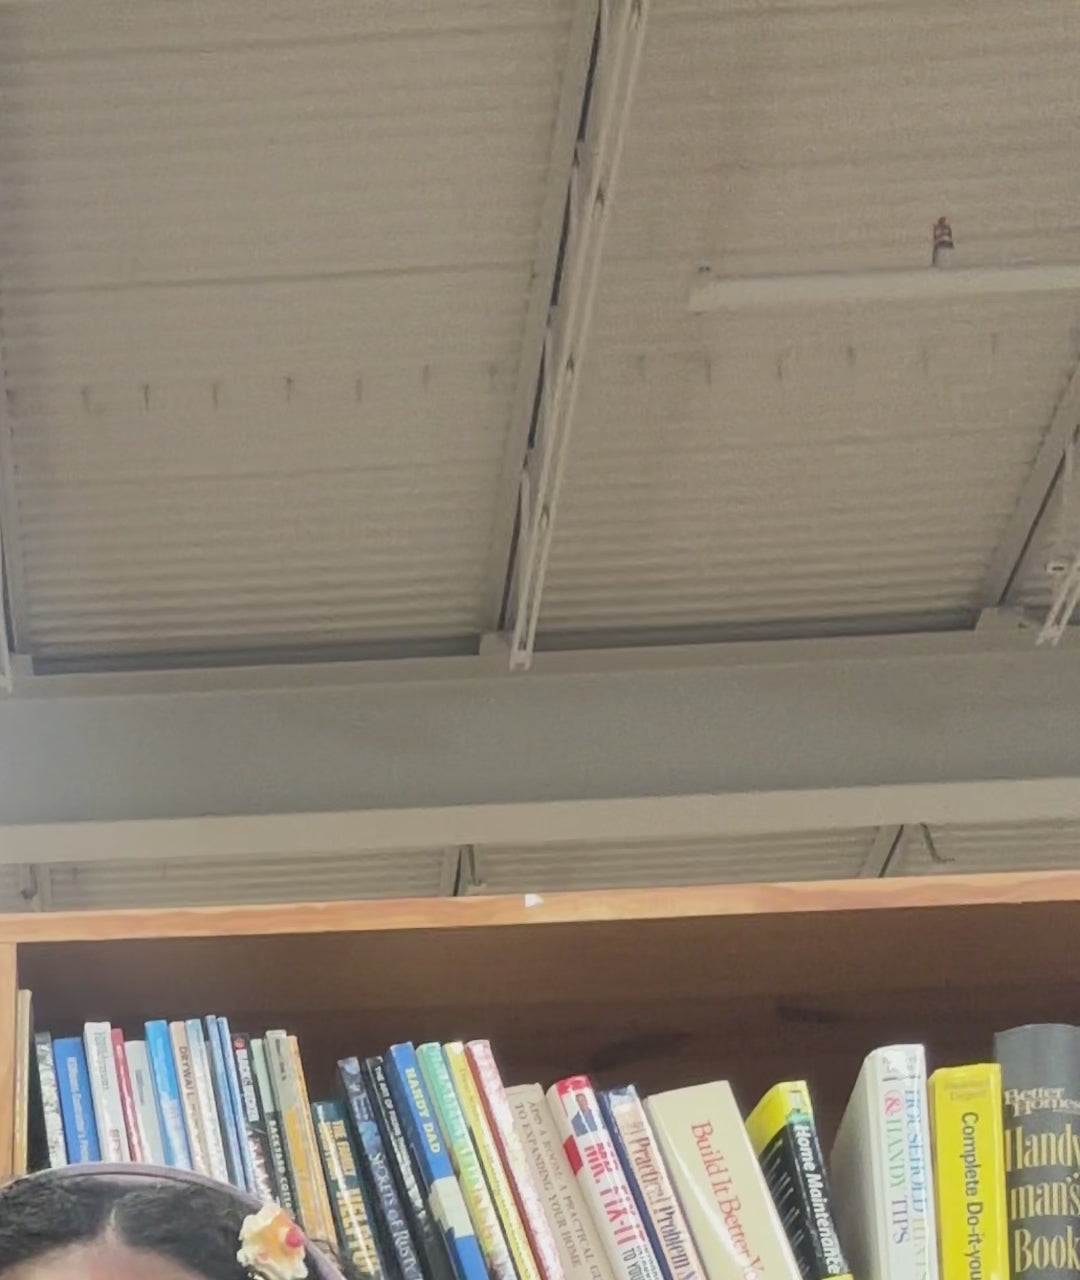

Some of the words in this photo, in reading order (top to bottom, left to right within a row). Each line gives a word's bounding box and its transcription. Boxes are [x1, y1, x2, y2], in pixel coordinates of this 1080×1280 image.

[405, 1067, 431, 1119] HANDY
[423, 1122, 442, 1155] DAD
[691, 1120, 725, 1176] Build
[793, 1124, 817, 1173] Home
[885, 1118, 908, 1190] HANDY
[959, 1111, 981, 1198] Complete
[711, 1175, 733, 1196] It
[718, 1197, 752, 1262] Better
[804, 1173, 841, 1276] Maintenance
[891, 1196, 911, 1245] TIPS
